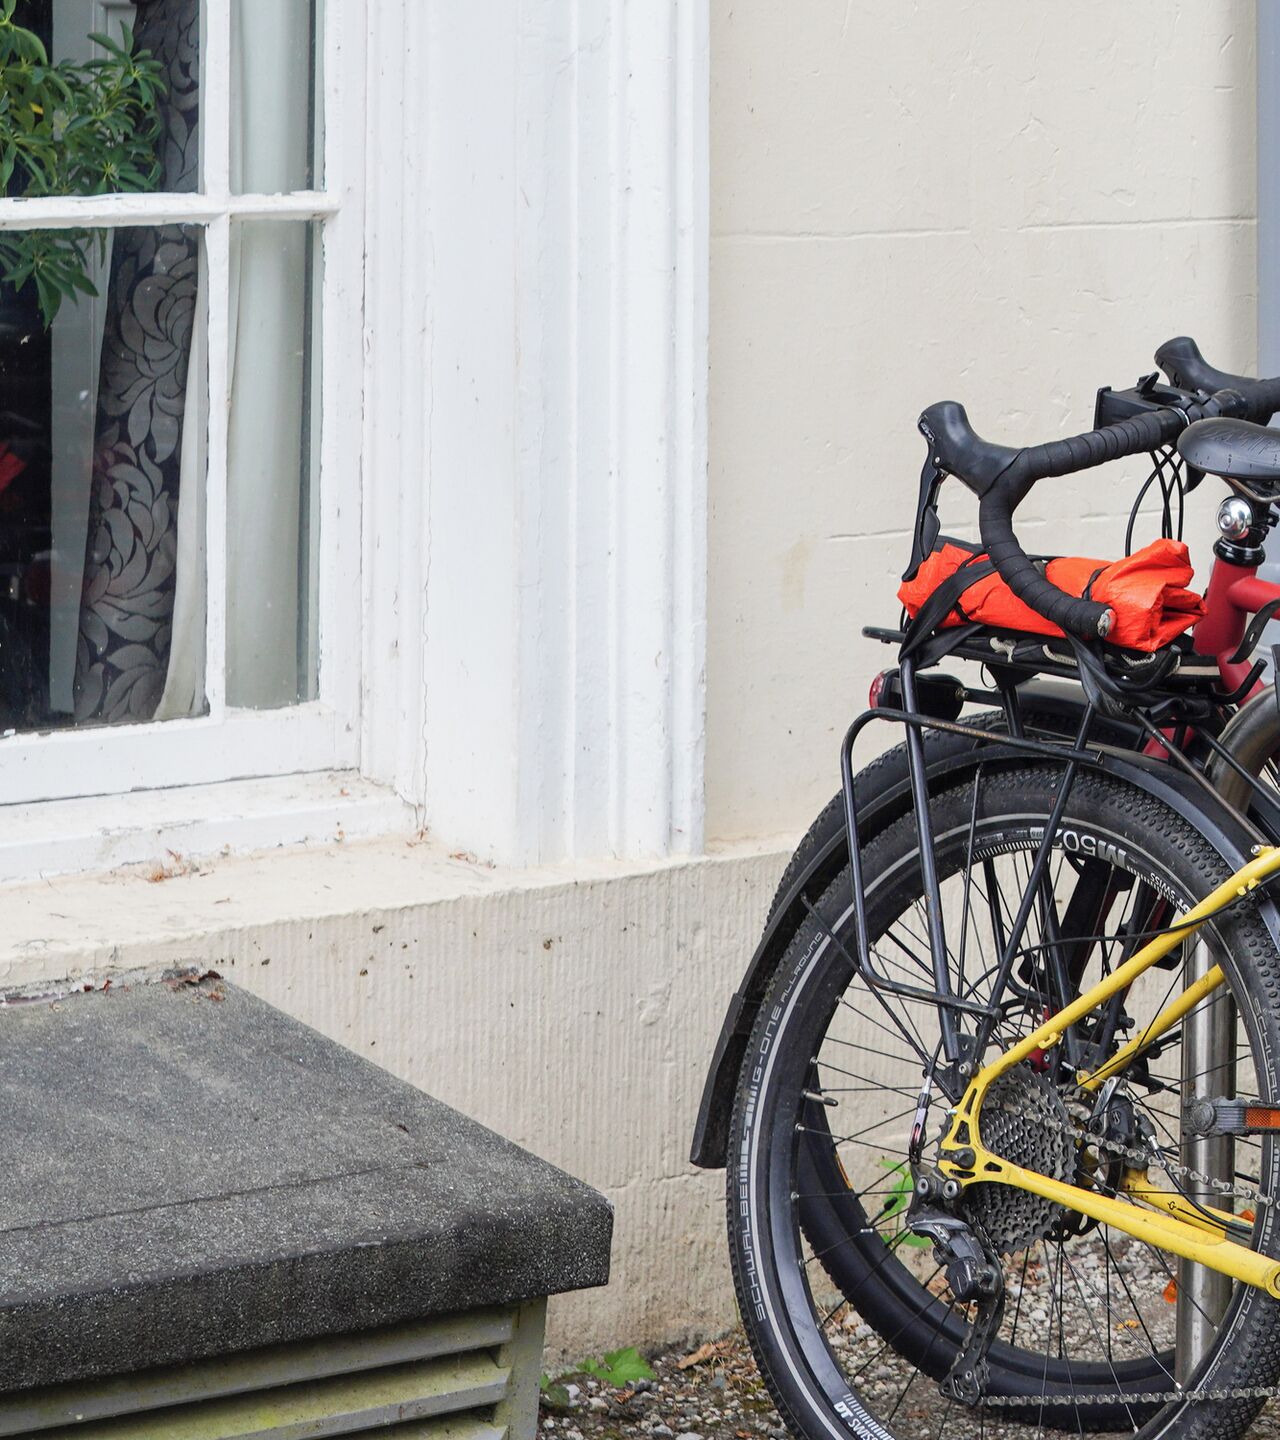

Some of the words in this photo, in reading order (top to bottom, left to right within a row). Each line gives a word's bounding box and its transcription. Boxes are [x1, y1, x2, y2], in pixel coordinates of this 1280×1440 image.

[738, 1182, 766, 1322] SCHWALBE
[752, 1004, 782, 1083] G-ONE
[780, 931, 823, 1005] ALLROUND
[833, 1401, 854, 1419] DT
